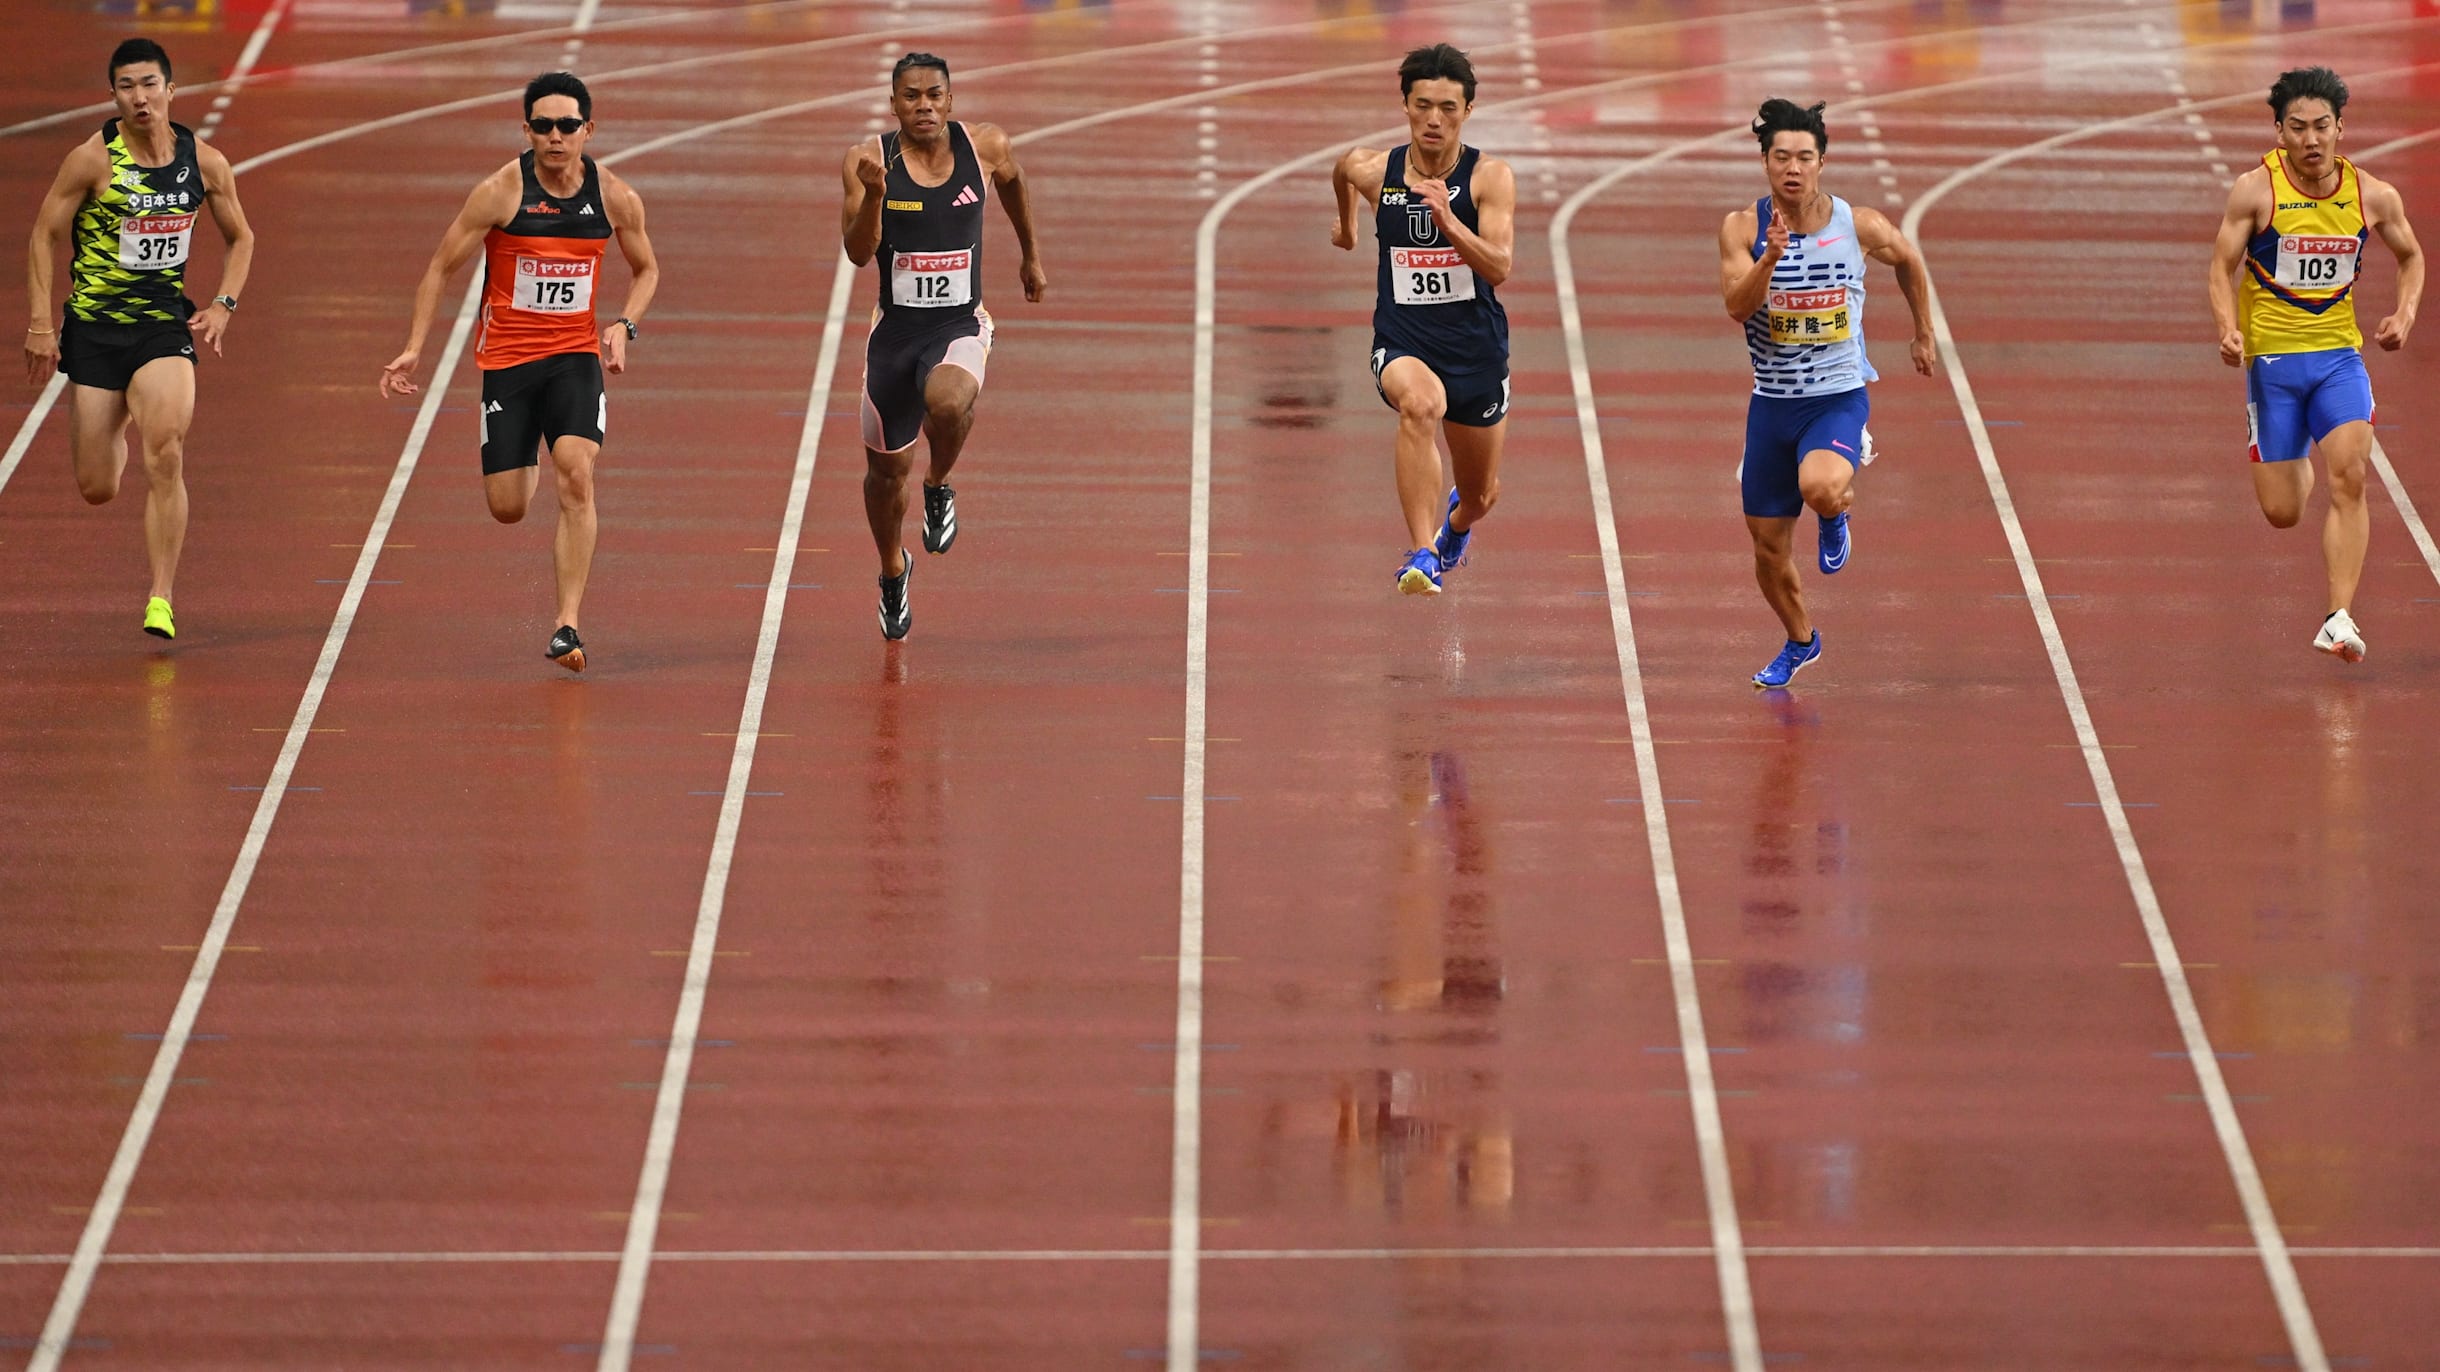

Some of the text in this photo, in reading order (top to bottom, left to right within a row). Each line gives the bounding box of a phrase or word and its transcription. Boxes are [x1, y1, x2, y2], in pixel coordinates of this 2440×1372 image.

[143, 192, 189, 207] 日本生命
[888, 201, 921, 209] SEIKO
[2278, 202, 2317, 210] SUZUKI
[143, 218, 190, 230] ヤマザキ
[138, 236, 179, 260] 375
[2302, 240, 2354, 251] ヤマザキ
[915, 256, 966, 269] ヤマザキ
[1411, 252, 1462, 264] ヤマザキ
[539, 263, 590, 274] ヤマザキ
[2298, 258, 2337, 280] 103
[915, 276, 950, 297] 112
[1411, 272, 1451, 294] 361
[536, 282, 575, 304] 175
[1790, 293, 1843, 307] ヤマザキ
[1804, 311, 1848, 333] 隆一郎
